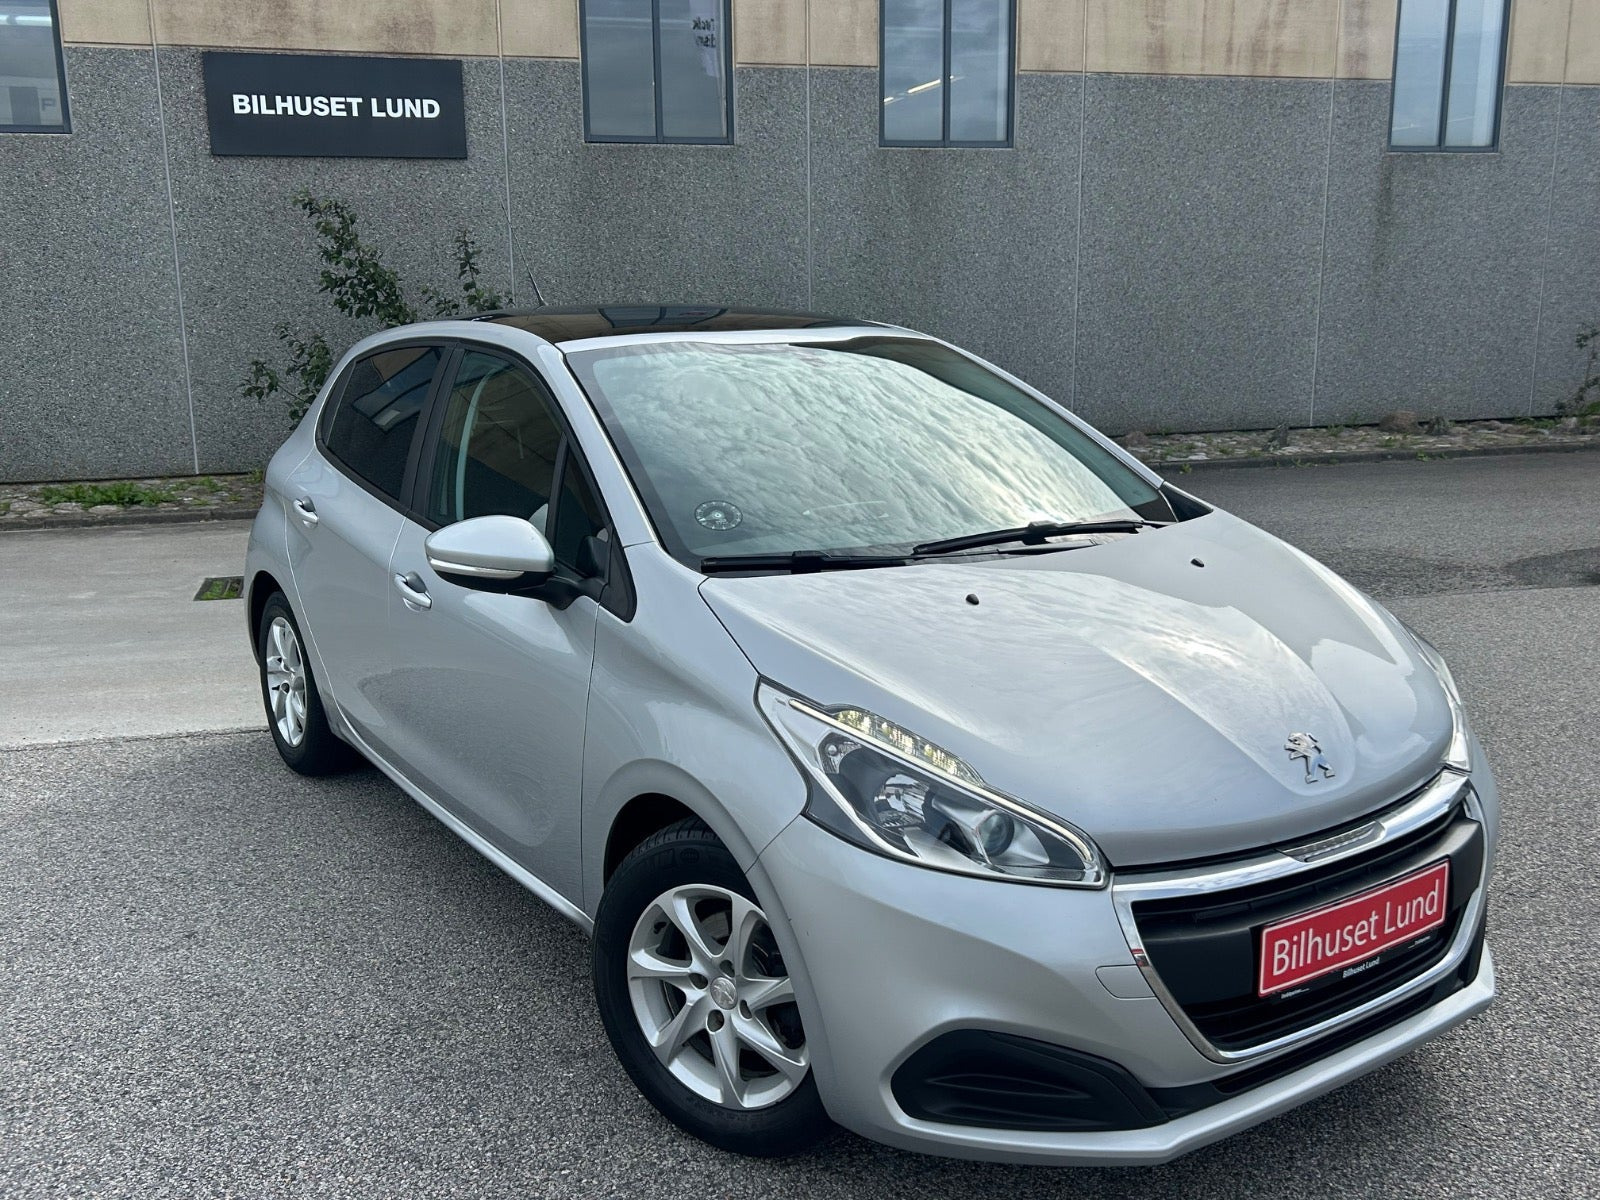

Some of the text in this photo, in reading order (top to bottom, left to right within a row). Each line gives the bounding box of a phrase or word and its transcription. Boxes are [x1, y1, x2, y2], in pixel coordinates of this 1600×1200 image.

[232, 94, 441, 119] BILHUSET LUND
[1272, 879, 1440, 977] Bilhuset Lund
[1342, 956, 1381, 979] Bilhuset Lund
